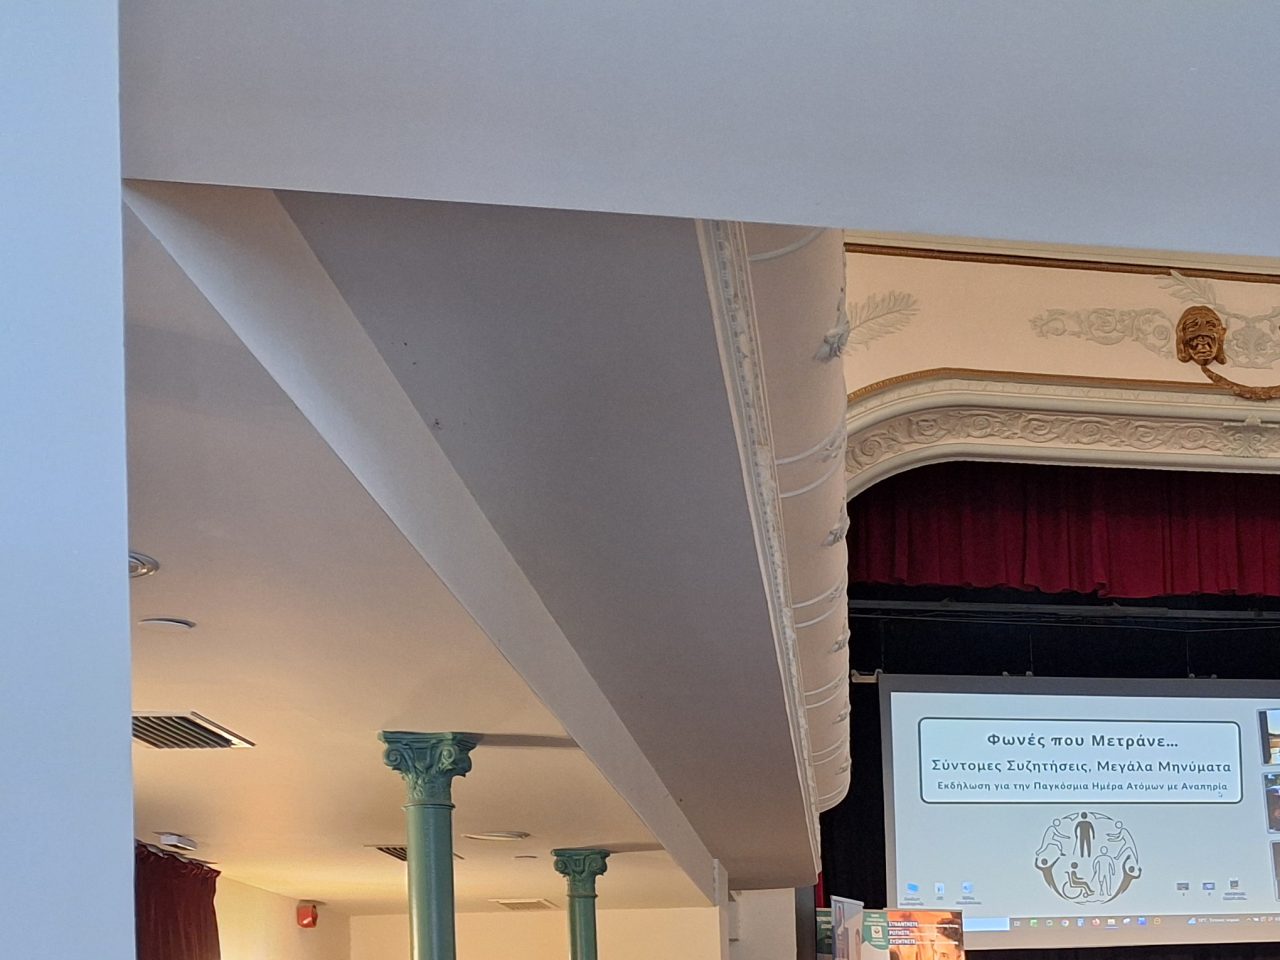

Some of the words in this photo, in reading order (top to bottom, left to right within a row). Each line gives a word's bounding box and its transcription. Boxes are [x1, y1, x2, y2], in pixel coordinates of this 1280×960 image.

[987, 733, 1045, 748] Φωνές
[1051, 736, 1084, 746] που
[931, 759, 1002, 773] Σύντομες
[1006, 760, 1092, 773] Συζητήσεις,
[1097, 761, 1153, 774] Μεγάλα
[1158, 761, 1231, 774] Μηνύματα
[937, 781, 991, 791] Εκδήλωση
[994, 783, 1010, 791] για
[1013, 783, 1030, 791] την
[1033, 782, 1089, 792] Παγκόσμια
[1092, 782, 1123, 791] Ημέρα
[1126, 782, 1164, 791] Ατόμων
[1181, 782, 1227, 792] Αναπηρία
